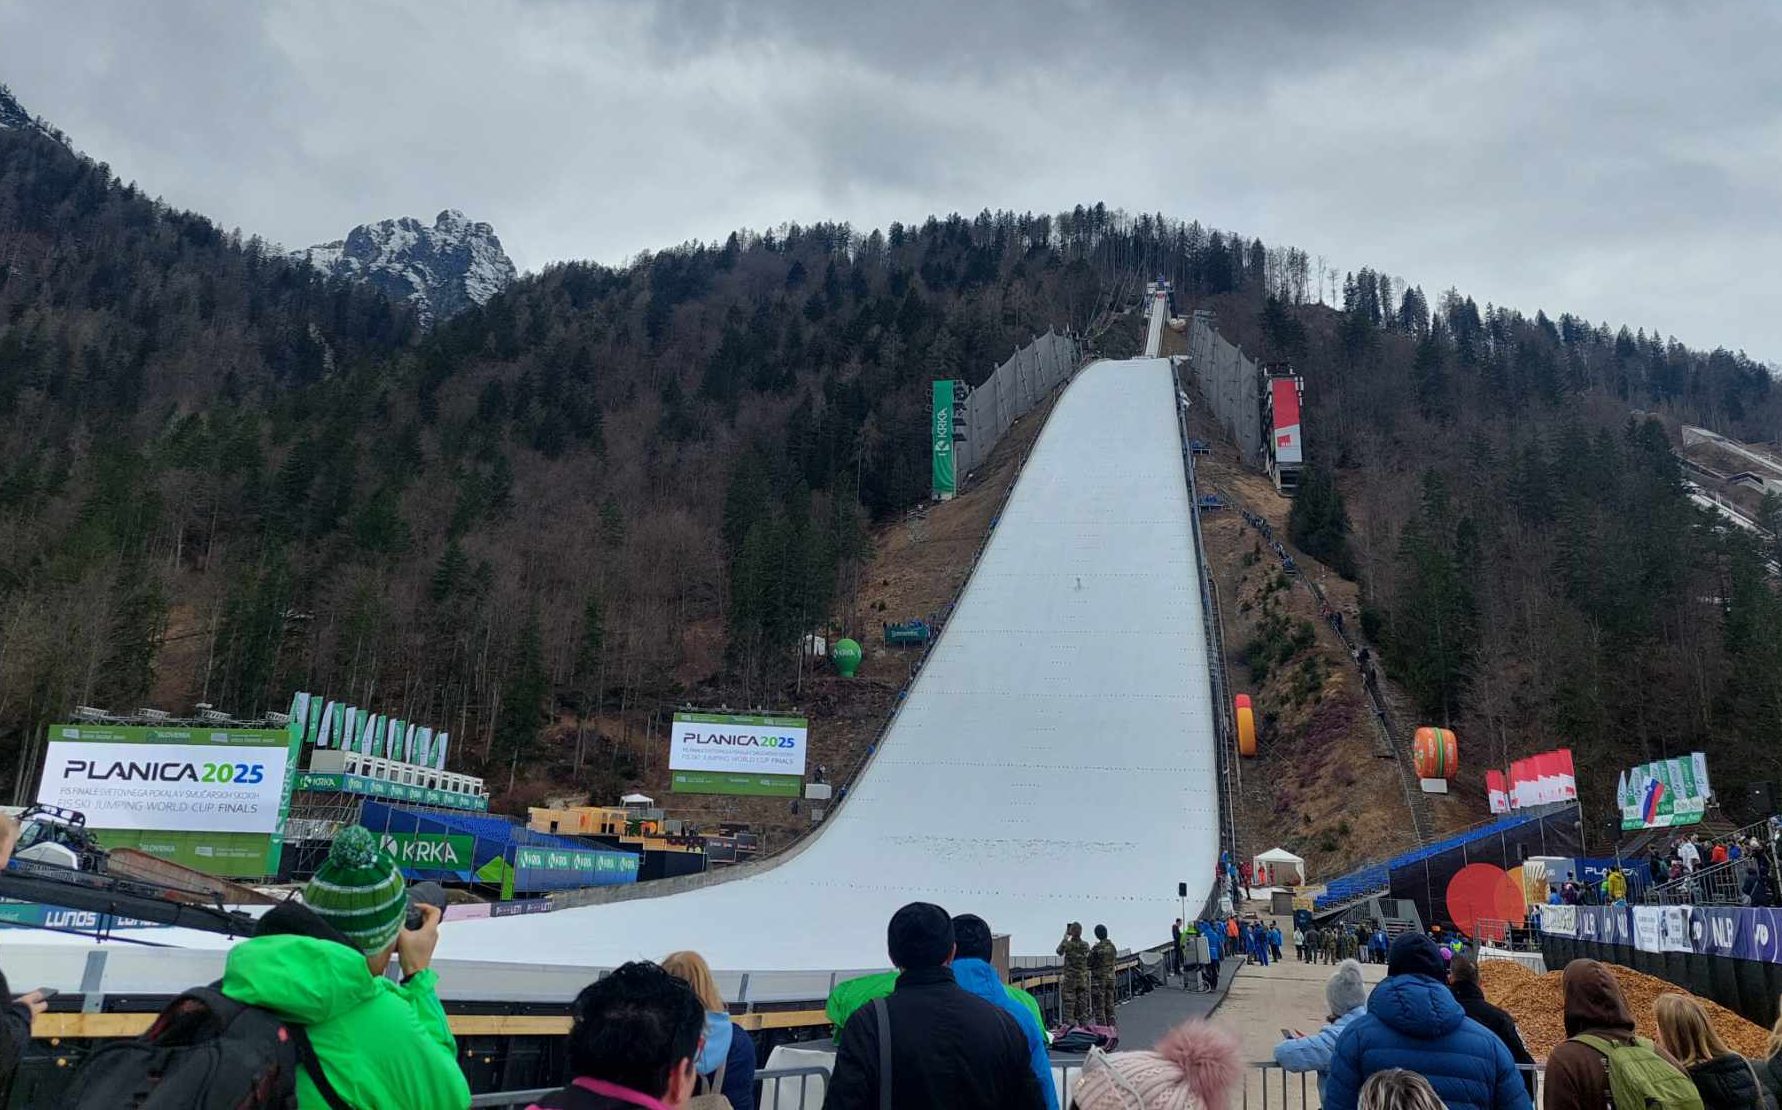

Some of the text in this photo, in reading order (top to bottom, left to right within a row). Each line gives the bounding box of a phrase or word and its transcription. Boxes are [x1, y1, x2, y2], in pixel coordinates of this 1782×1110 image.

[937, 408, 948, 437] KRKA
[95, 800, 144, 812] JUMPING
[147, 801, 188, 813] WORLD
[191, 802, 215, 813] CUP
[218, 803, 258, 814] FINALS
[402, 840, 459, 864] KRKA
[44, 911, 97, 927] LUNOS
[1712, 916, 1734, 948] NLB
